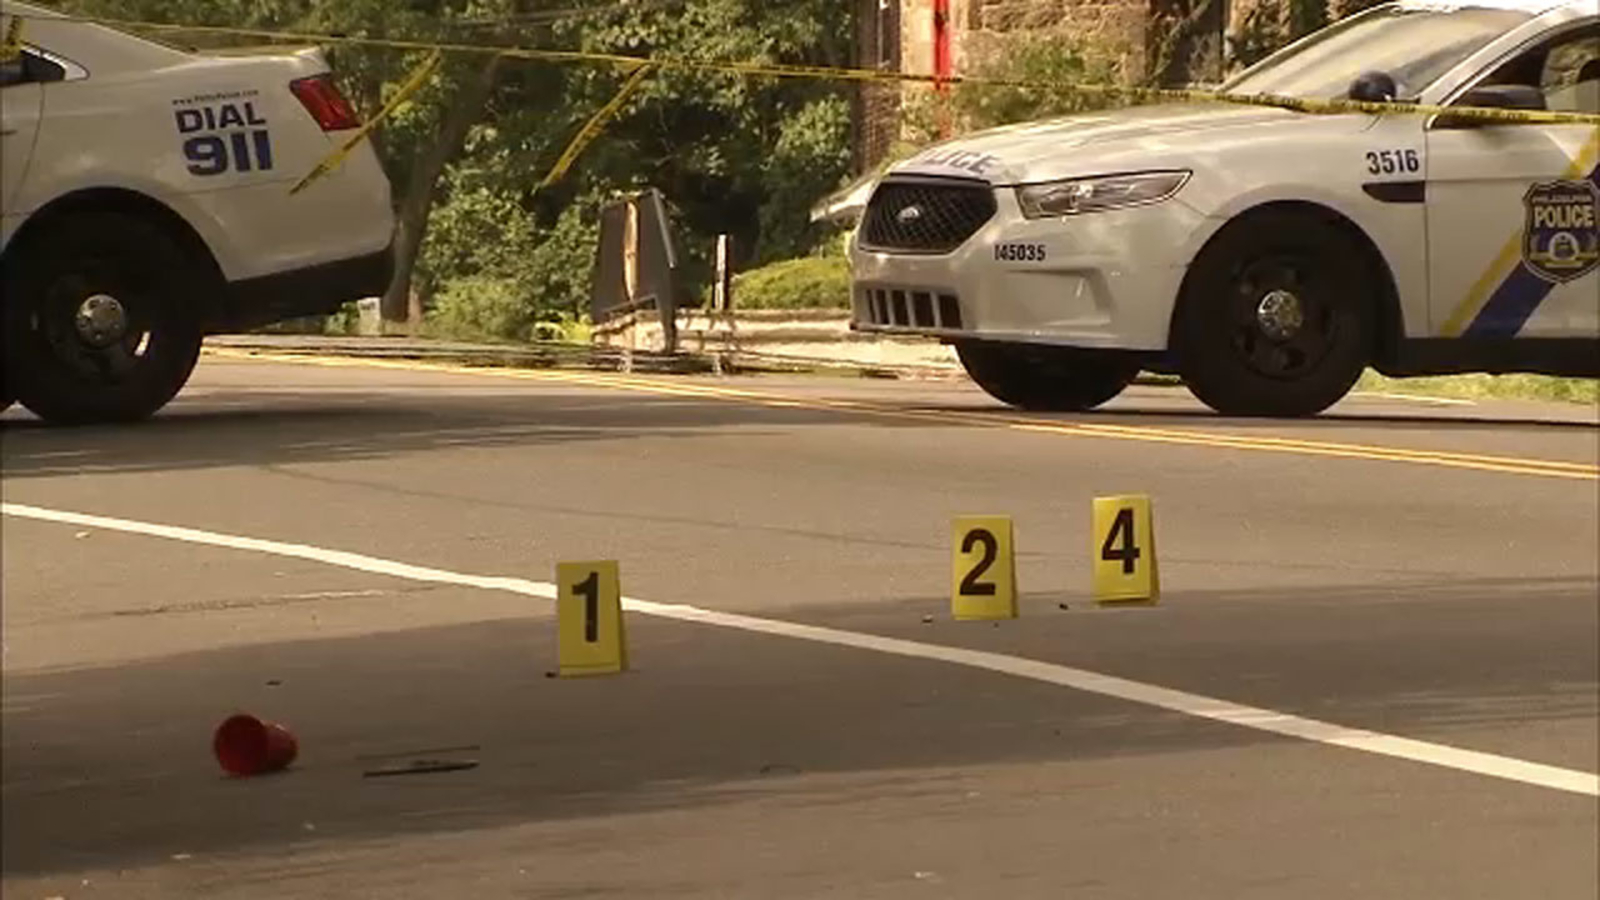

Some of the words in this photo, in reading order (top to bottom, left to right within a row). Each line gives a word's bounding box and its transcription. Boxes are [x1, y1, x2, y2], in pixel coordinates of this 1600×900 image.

[175, 102, 267, 133] DIAL
[183, 130, 272, 176] 911
[1366, 149, 1419, 175] 3516
[1534, 204, 1594, 228] POLICE
[959, 528, 998, 596] 2
[1101, 507, 1141, 574] 4
[571, 571, 599, 643] 1
